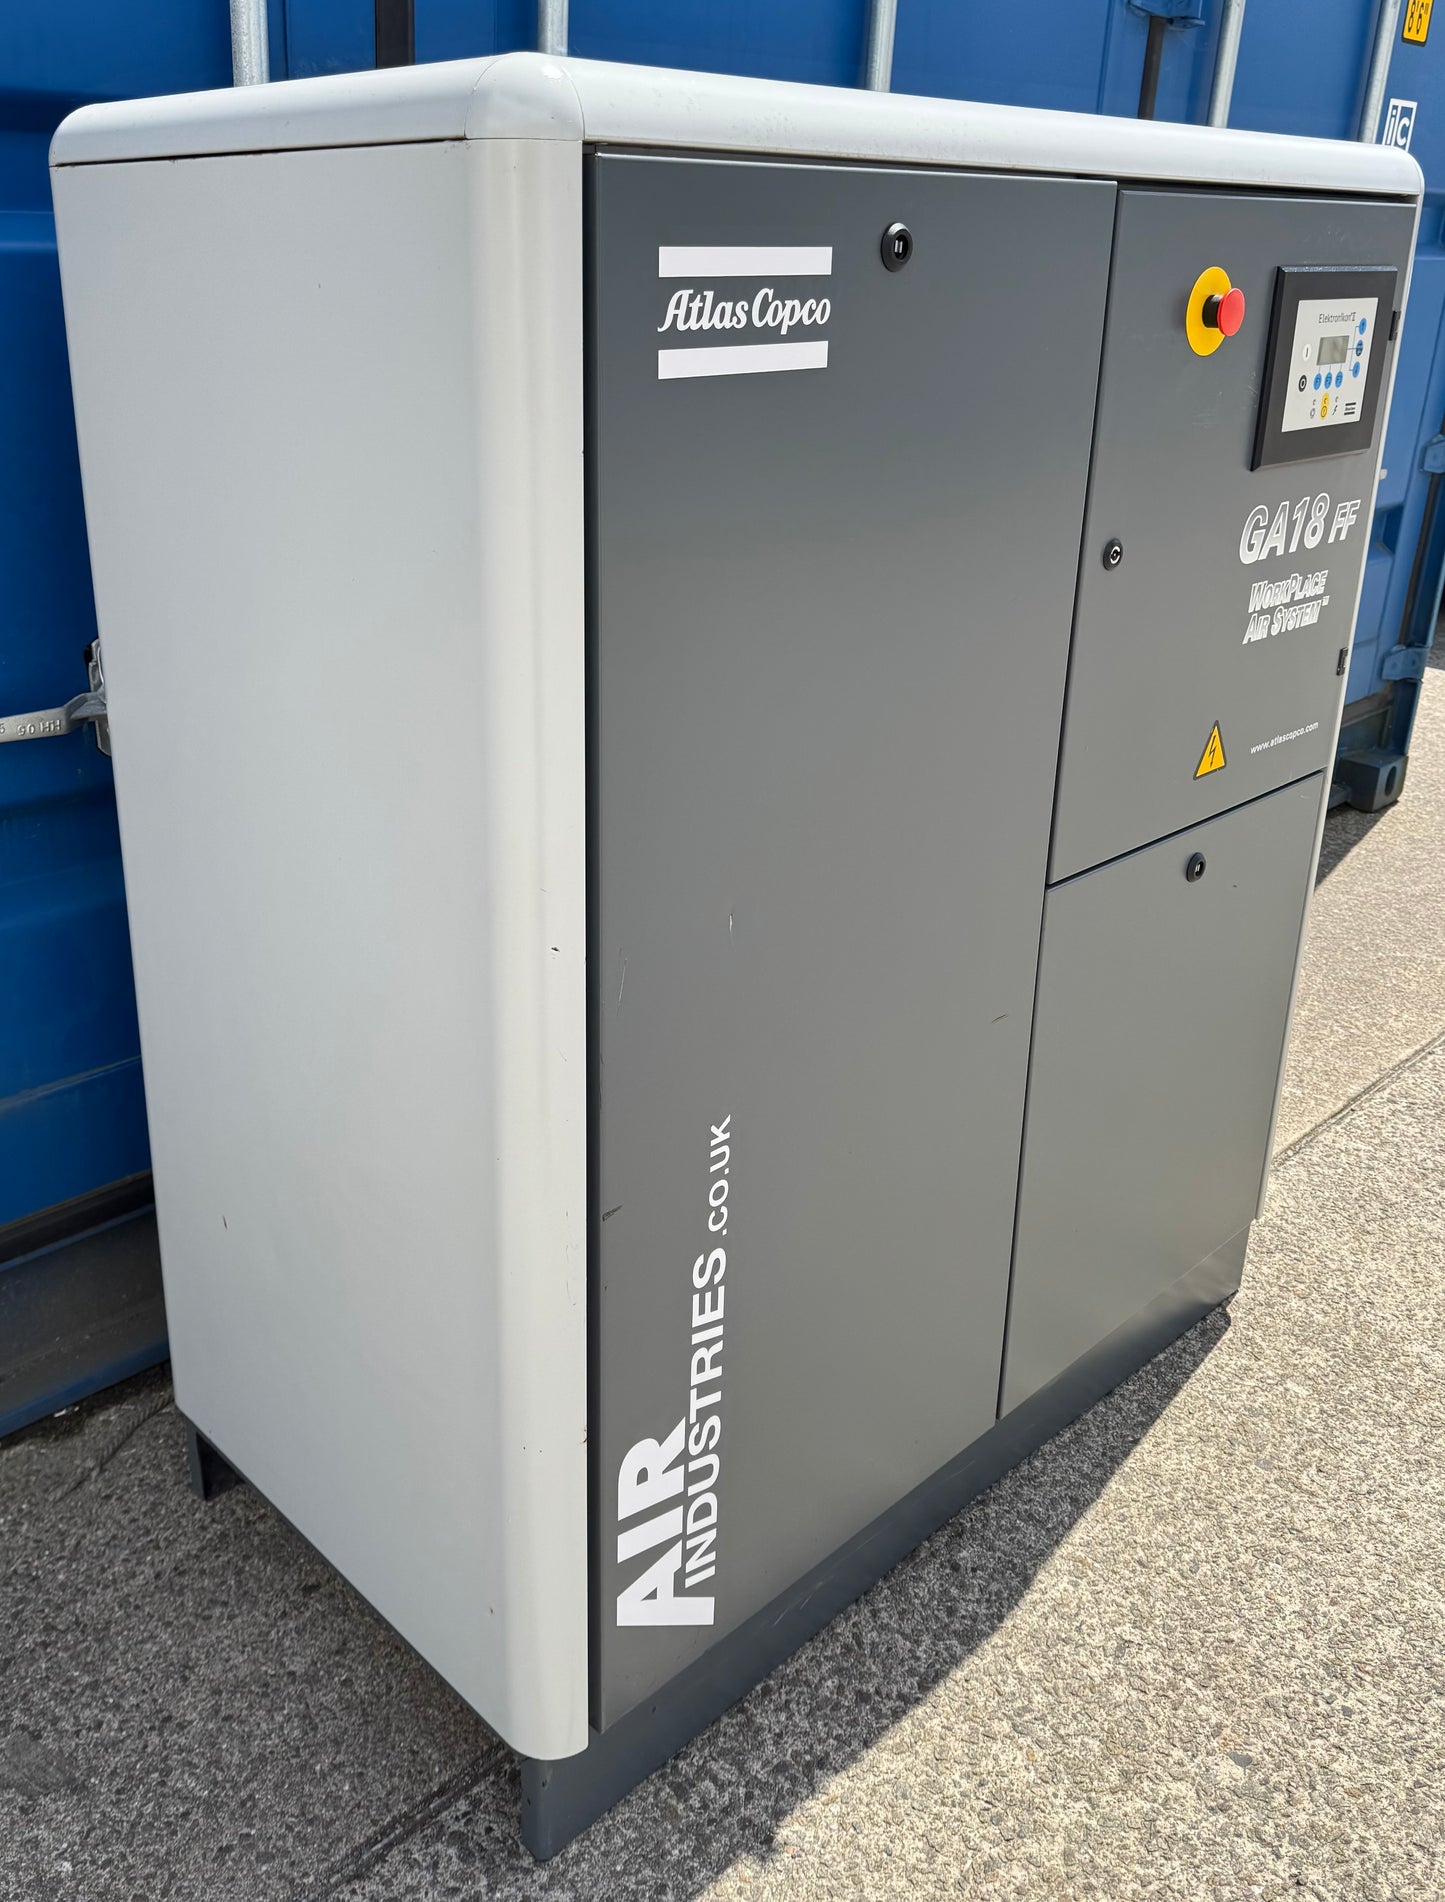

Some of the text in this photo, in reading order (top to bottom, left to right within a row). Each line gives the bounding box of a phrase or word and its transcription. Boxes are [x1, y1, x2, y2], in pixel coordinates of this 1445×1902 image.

[657, 287, 831, 335] Atlas Copco
[1239, 492, 1361, 565] GA18 FF
[1242, 613, 1271, 645] AIR
[1250, 721, 1319, 754] www.atlascopco.com
[616, 1415, 716, 1626] AIR
